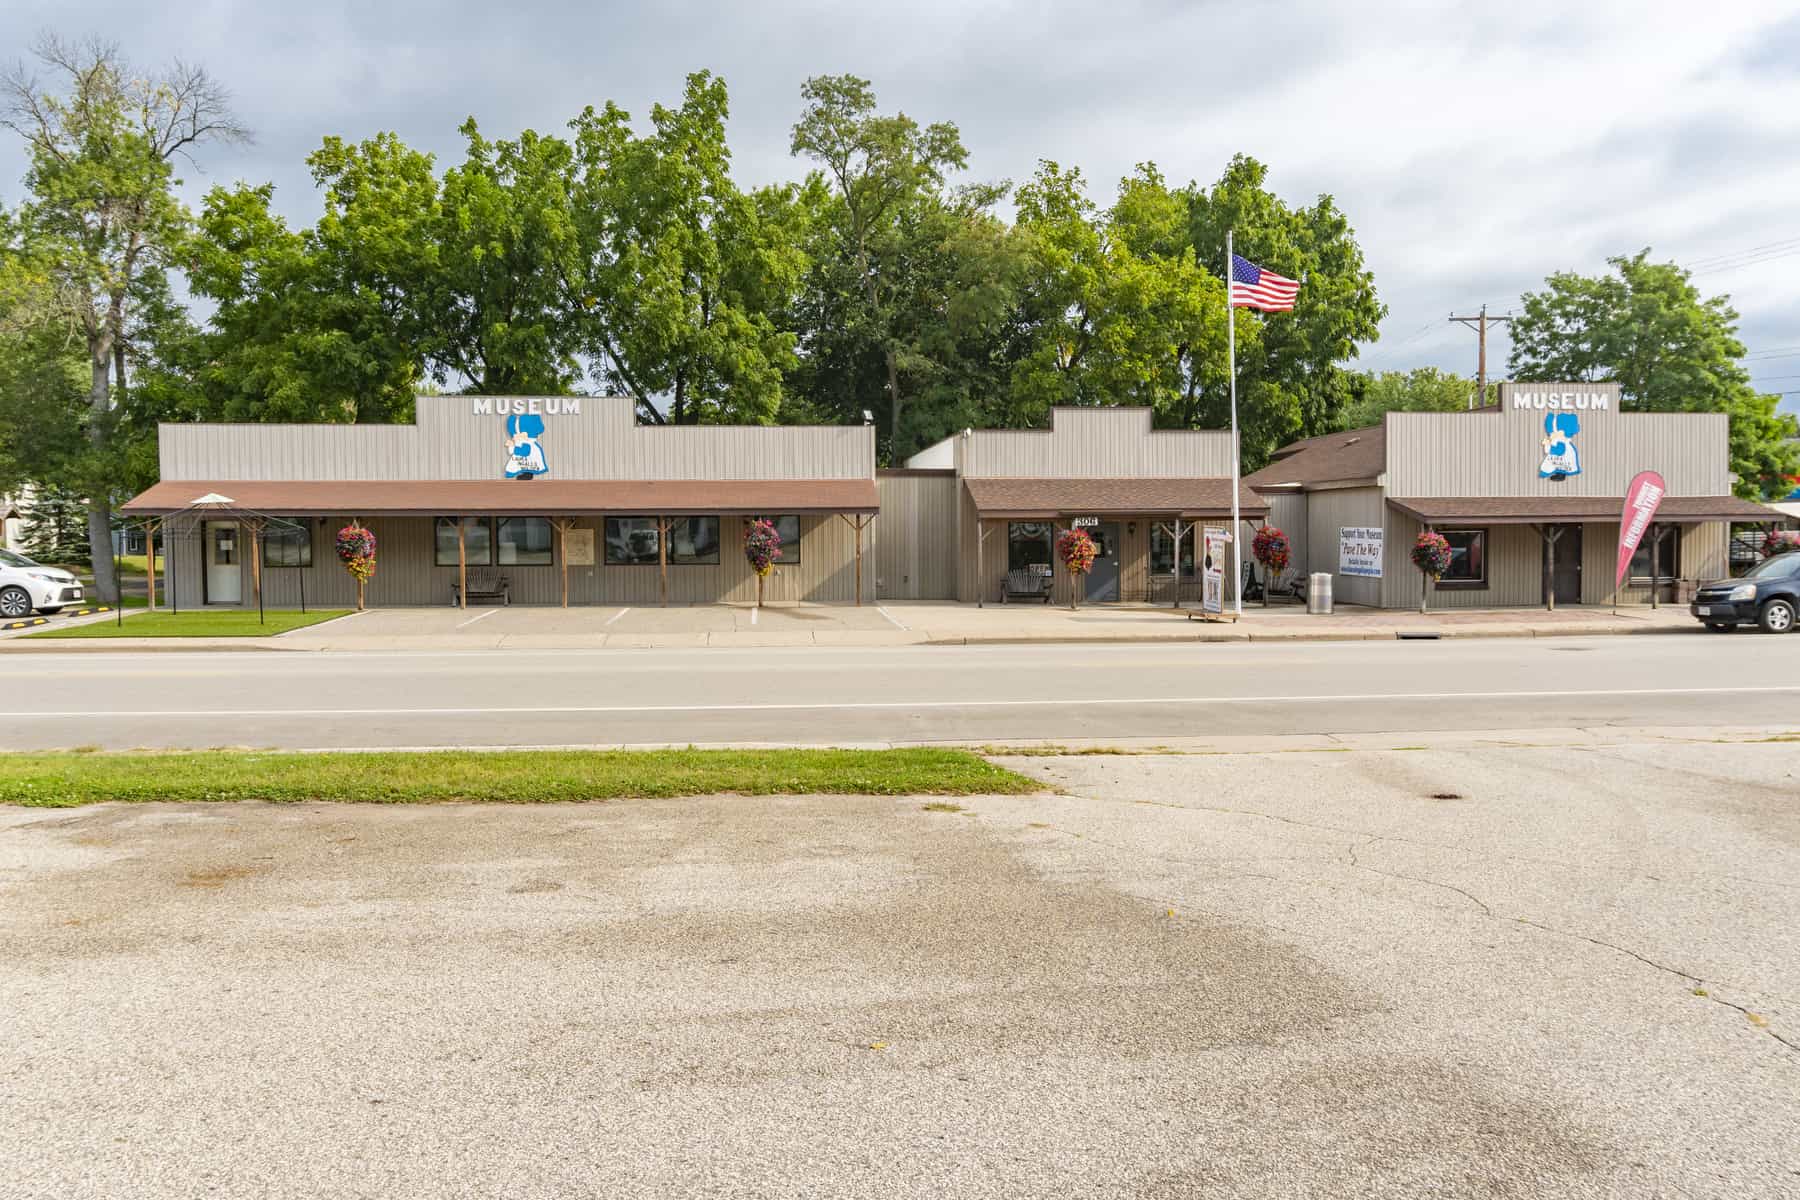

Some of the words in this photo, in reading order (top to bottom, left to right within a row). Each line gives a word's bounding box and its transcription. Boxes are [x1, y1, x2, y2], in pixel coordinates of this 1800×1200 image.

[472, 398, 581, 415] MUSEUM
[1513, 391, 1608, 410] MUSEUM
[1623, 485, 1664, 549] INFORMATION
[1341, 527, 1356, 541] Support
[1356, 543, 1368, 556] The
